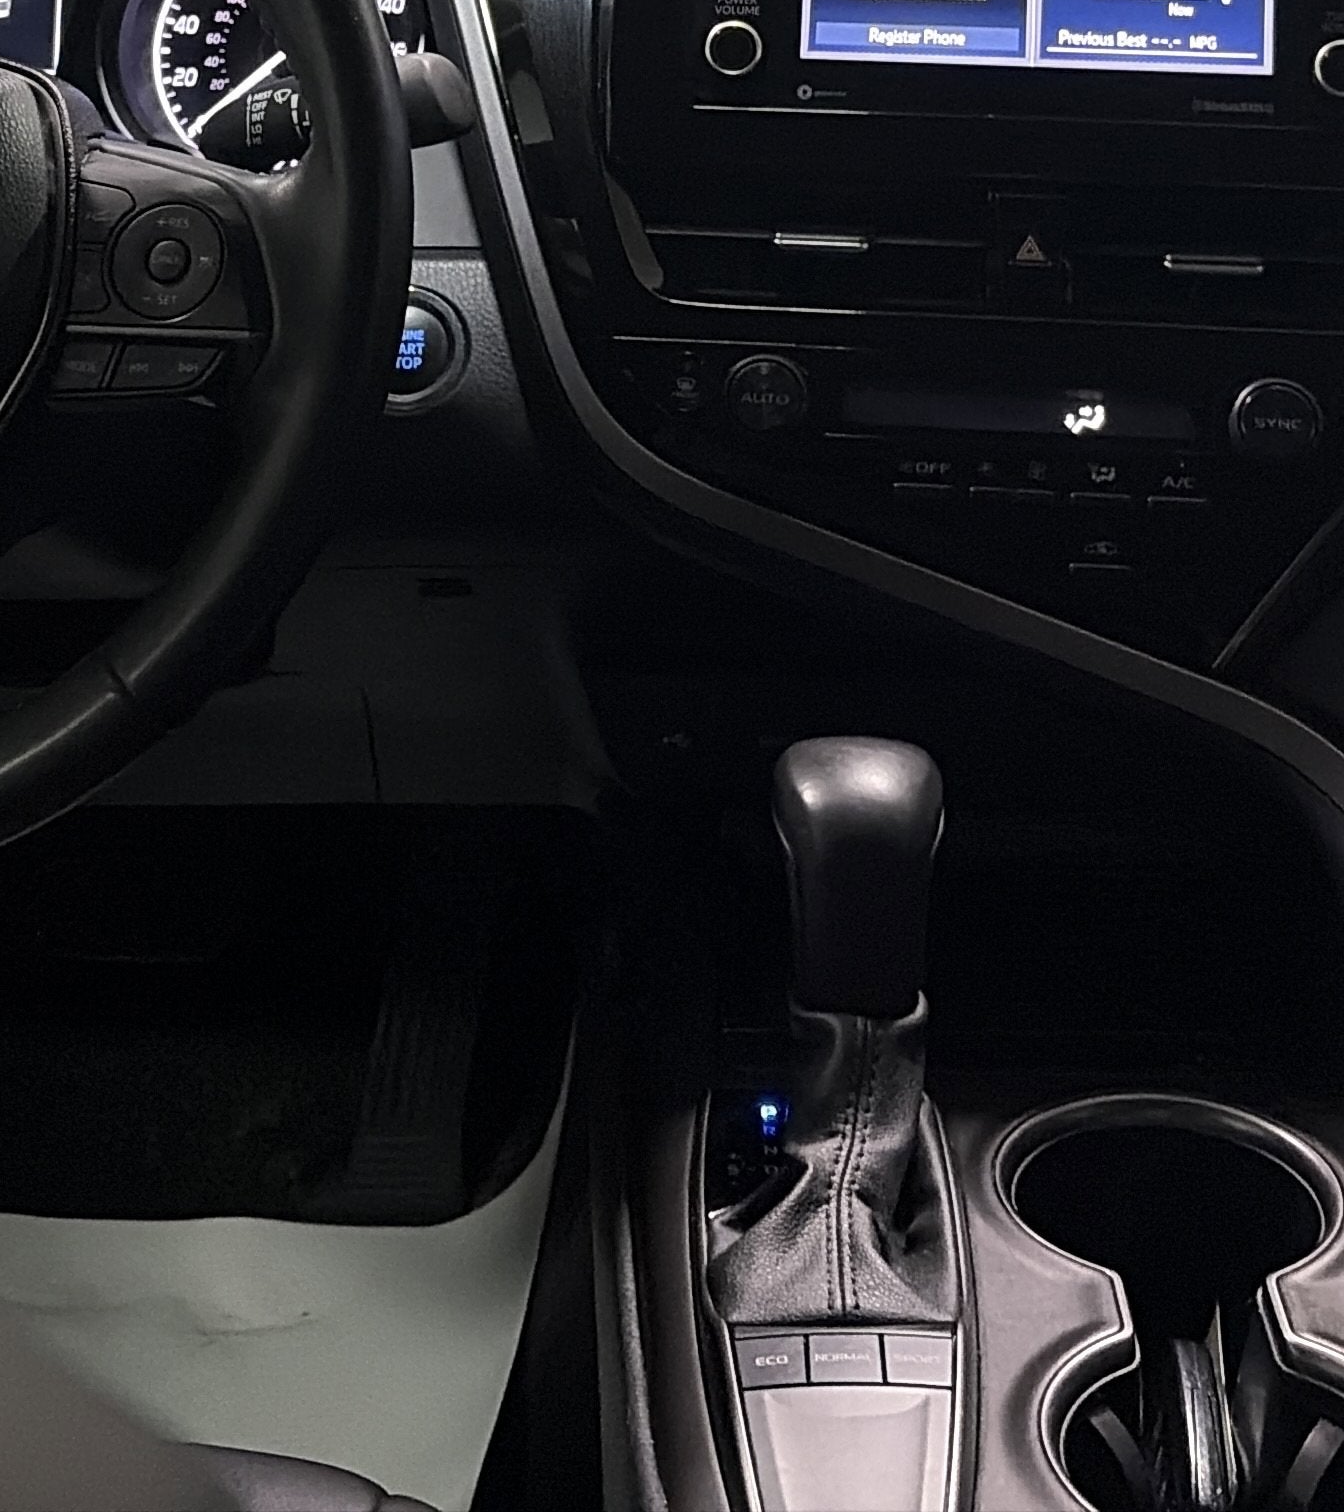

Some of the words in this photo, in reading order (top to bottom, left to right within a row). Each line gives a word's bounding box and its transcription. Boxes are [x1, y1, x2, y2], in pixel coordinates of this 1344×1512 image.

[715, 5, 760, 16] VOLUME
[1168, 2, 1194, 16] Now
[214, 11, 230, 22] 80
[173, 15, 200, 34] 40
[206, 32, 221, 44] 60
[868, 27, 921, 46] Register
[923, 28, 967, 46] Phone
[1058, 28, 1115, 46] Previous
[1116, 31, 1148, 48] Best
[1189, 35, 1218, 50] MPG
[204, 56, 219, 67] 40
[172, 67, 198, 87] 20
[209, 78, 224, 90] 20
[252, 101, 268, 112] OFF
[252, 112, 266, 123] INT
[399, 343, 425, 355] ART
[396, 357, 422, 369] TOP
[740, 392, 790, 406] AUTO
[1253, 415, 1303, 431] SYNC
[915, 460, 951, 475] OFF
[1162, 474, 1196, 490] A/C
[755, 1354, 789, 1367] ECO
